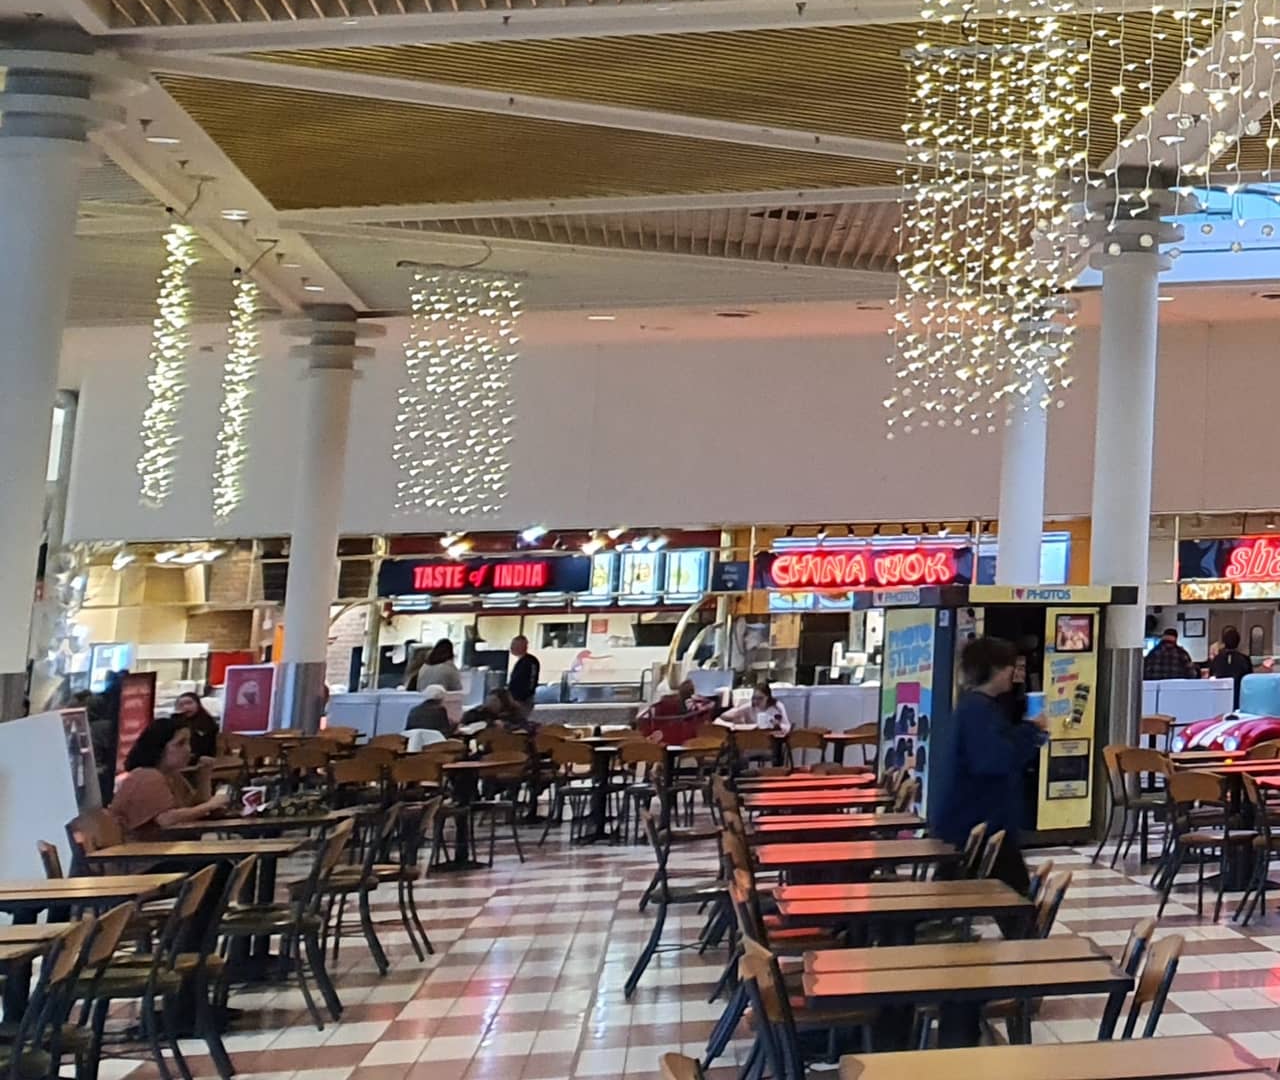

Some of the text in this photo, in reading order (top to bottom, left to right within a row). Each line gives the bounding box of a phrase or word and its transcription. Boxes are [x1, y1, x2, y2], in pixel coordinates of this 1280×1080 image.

[413, 562, 545, 589] TASTE of INDIA
[771, 554, 866, 585] CHINA
[874, 552, 949, 584] WOK
[1027, 589, 1071, 600] PHOTOS
